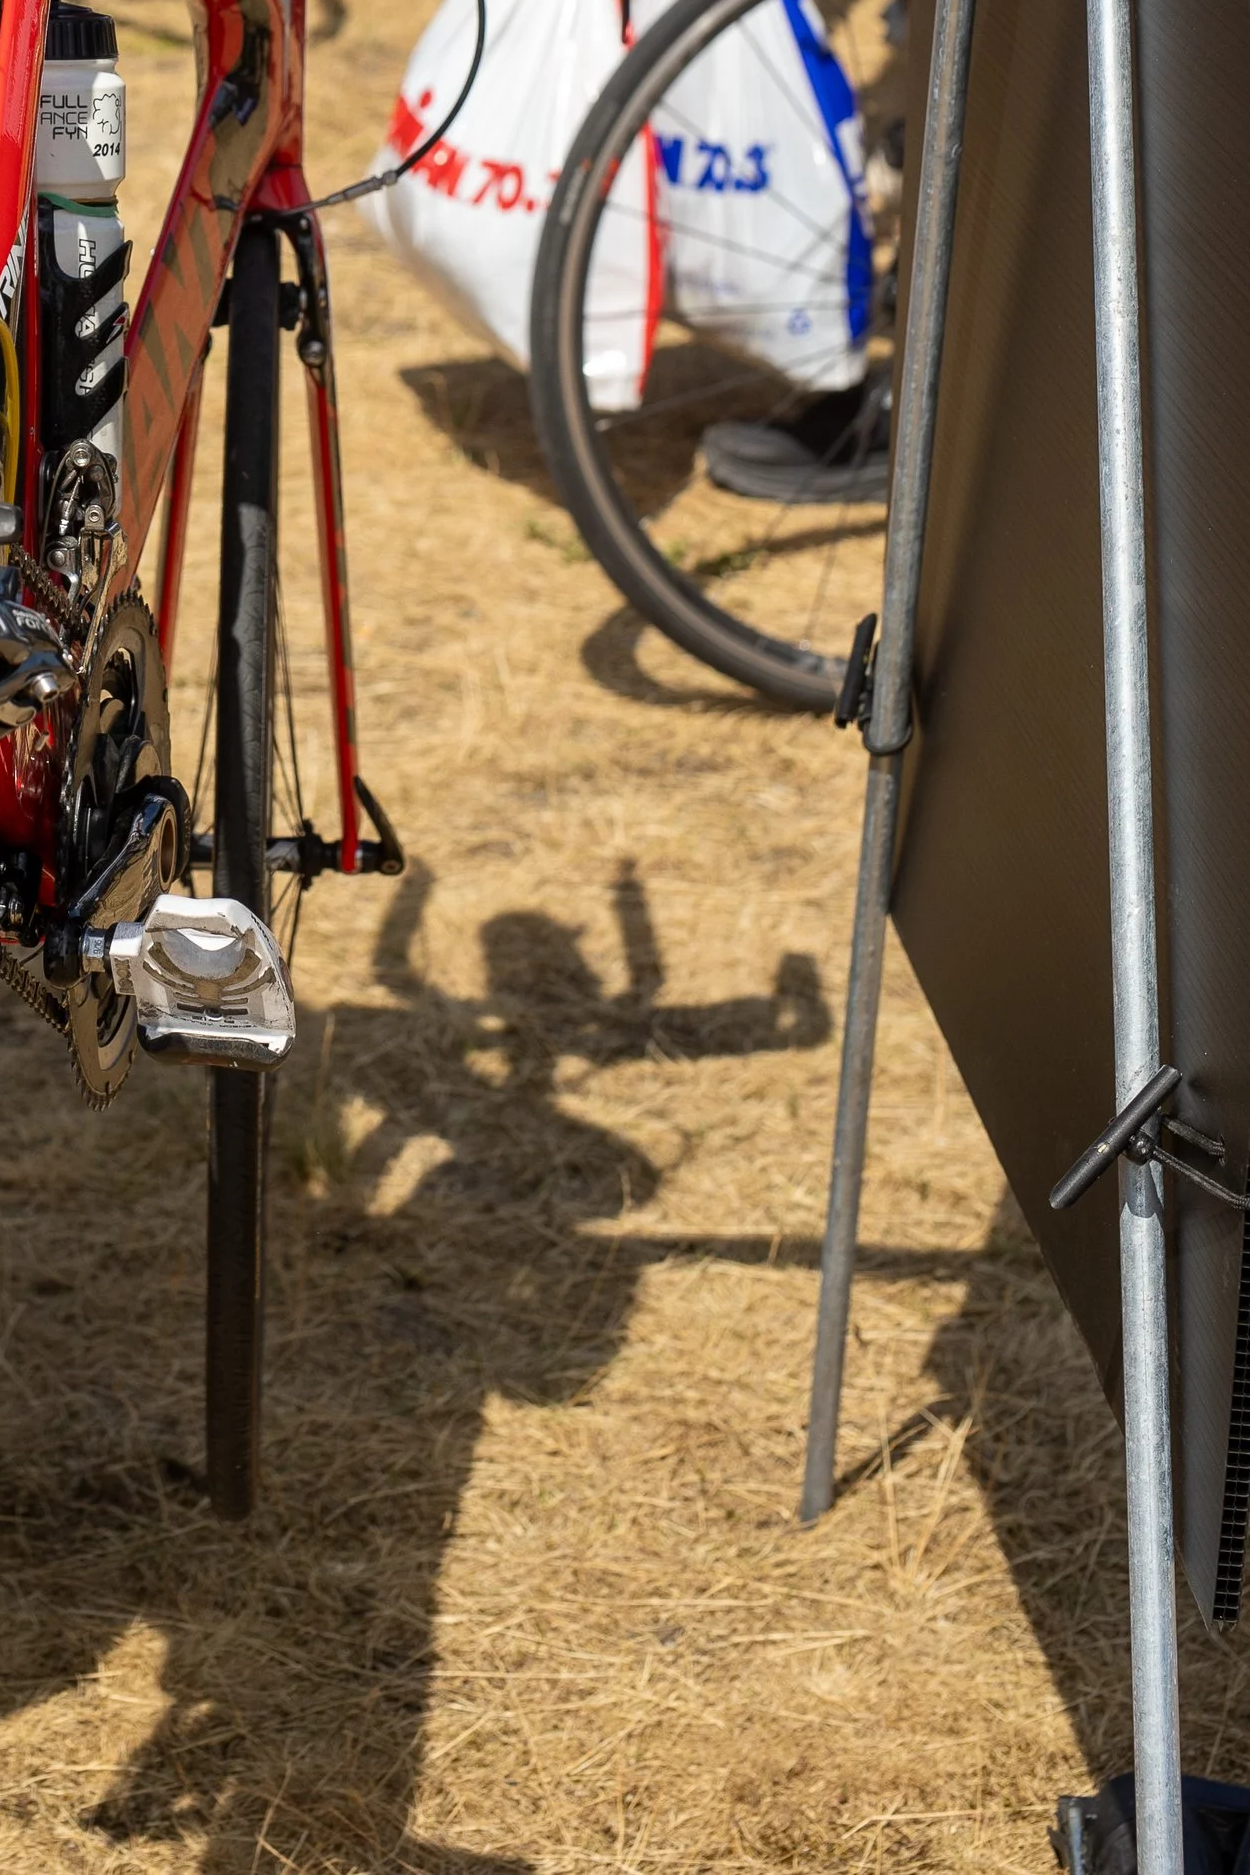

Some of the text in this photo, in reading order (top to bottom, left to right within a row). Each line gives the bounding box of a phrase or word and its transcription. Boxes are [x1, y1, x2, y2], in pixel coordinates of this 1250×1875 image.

[40, 94, 88, 109] FULL
[40, 111, 88, 125] ANCE
[52, 126, 88, 140] FYN
[92, 142, 121, 157] 2014
